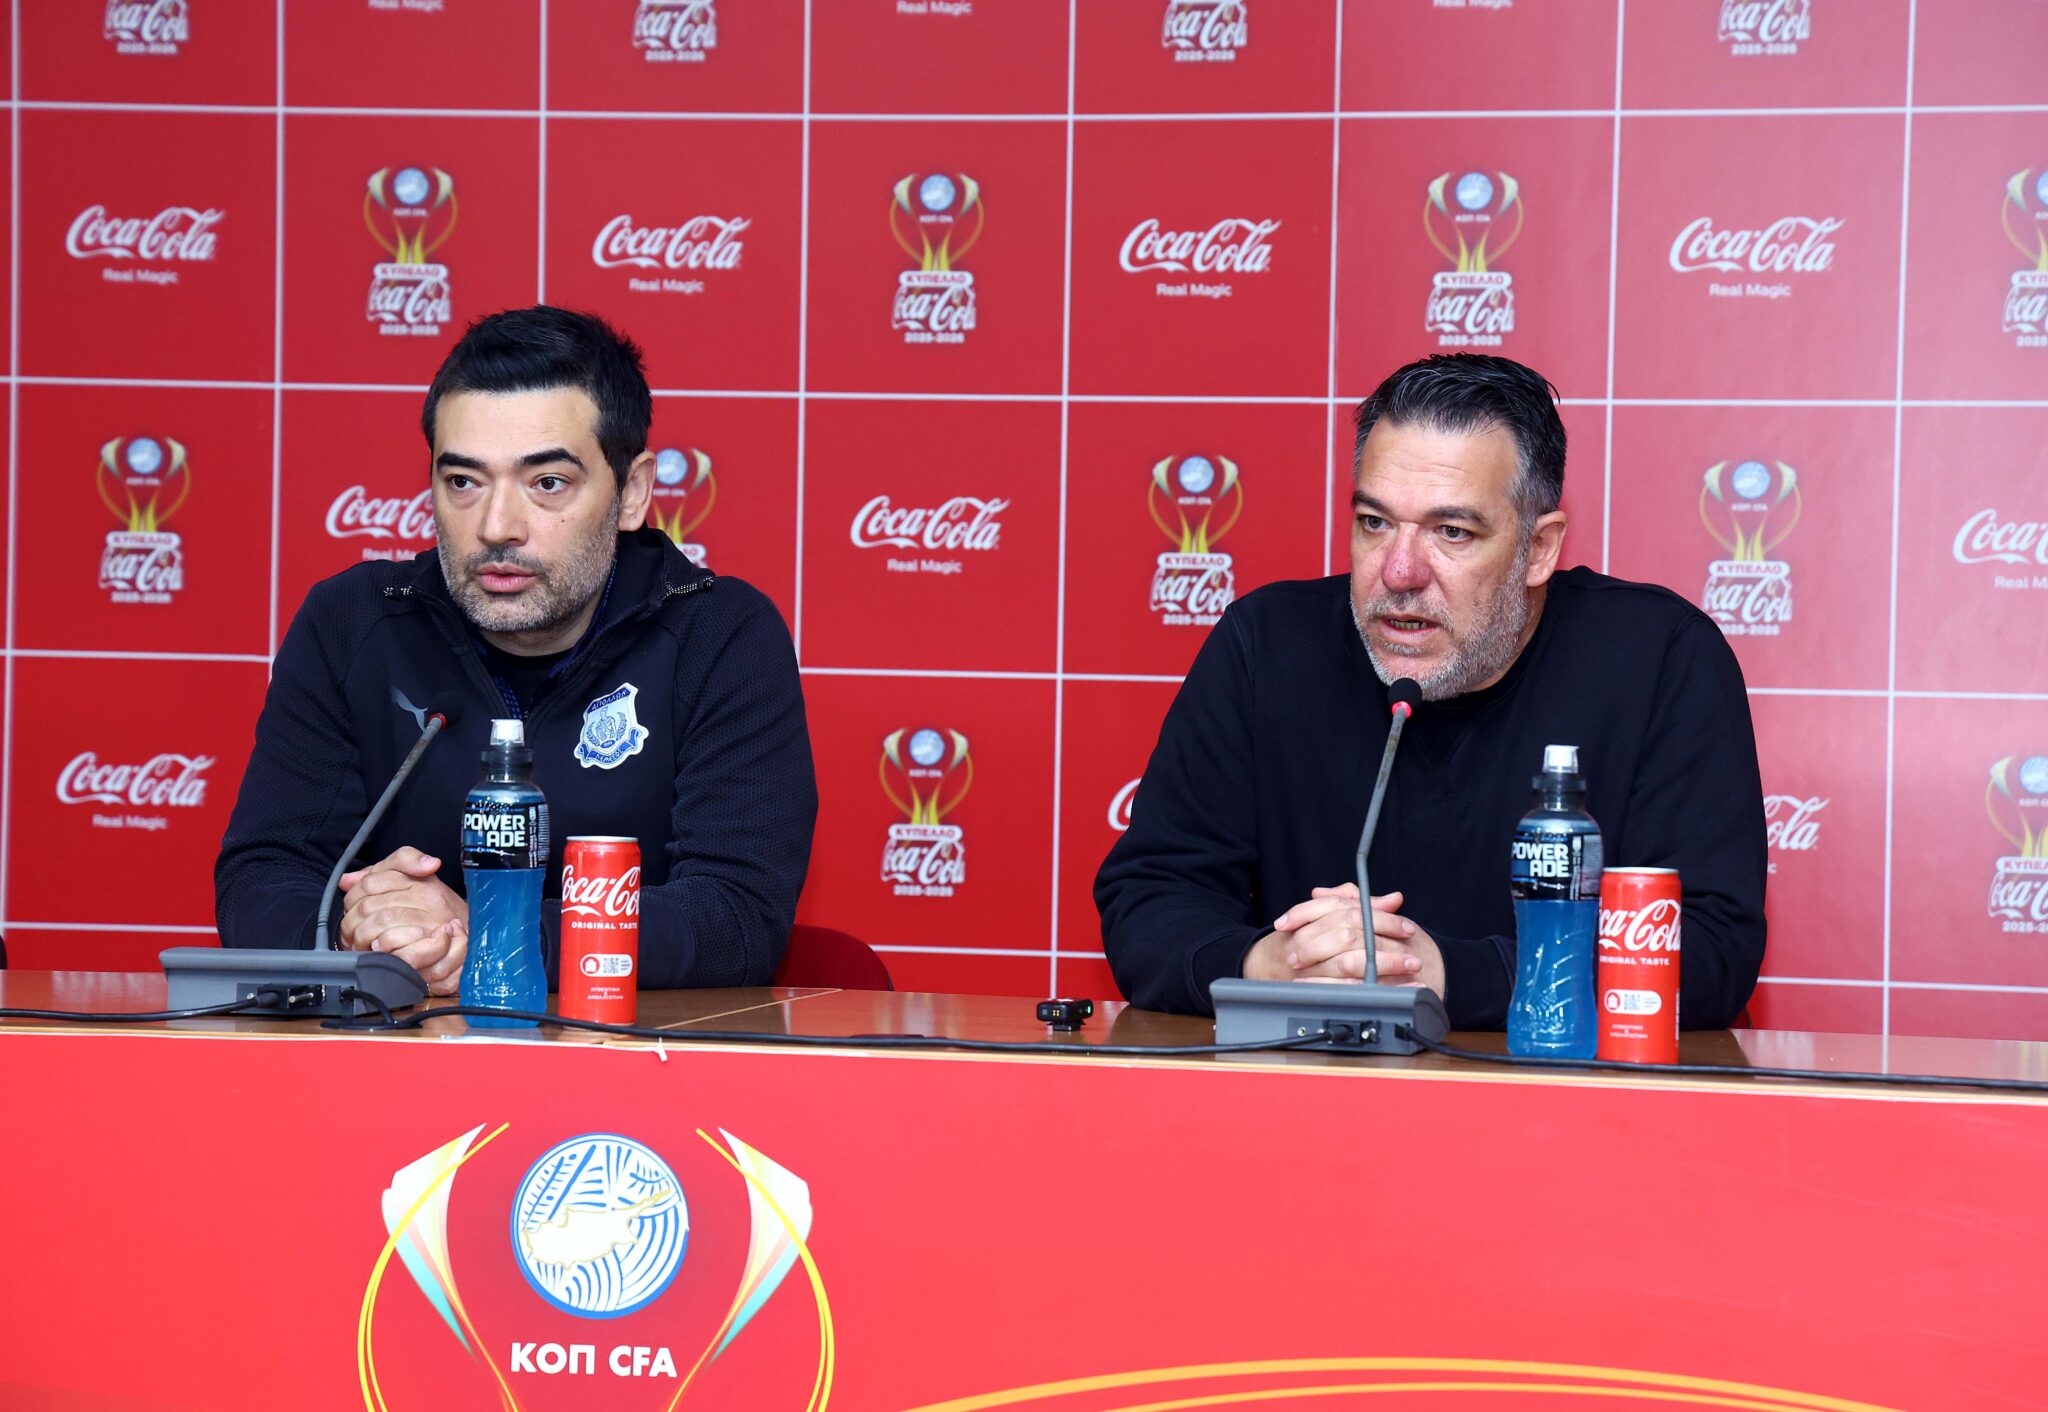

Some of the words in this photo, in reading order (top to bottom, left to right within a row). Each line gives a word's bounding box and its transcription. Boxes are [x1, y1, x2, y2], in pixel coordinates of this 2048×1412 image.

[65, 204, 225, 261] Coca-Cola
[592, 214, 752, 269] Coca-Cola
[1119, 218, 1282, 273] Coca-Cola
[1669, 216, 1846, 273] Coca-Cola
[1440, 275, 1504, 285] ΚΥΠΕΛΛΟ
[1156, 283, 1187, 296] Real
[1190, 284, 1232, 298] Magic
[1709, 283, 1742, 296] Real
[1746, 283, 1791, 299] Magic
[325, 485, 438, 539] Coca-Co
[850, 495, 1011, 550] Coca-Cola
[1717, 565, 1782, 573] ΚΥΠΕΛΛΟ
[591, 689, 627, 711] ΑΠΟΛΛΩΝ
[55, 751, 217, 806] Coca-Cola
[464, 814, 525, 830] POWER
[486, 831, 525, 847] ADE
[1530, 860, 1569, 877] ADE
[571, 921, 616, 930] ORIGINAL
[1640, 957, 1670, 966] TASTE
[510, 1342, 597, 1375] ΚΟΠ
[608, 1344, 678, 1378] CFA
